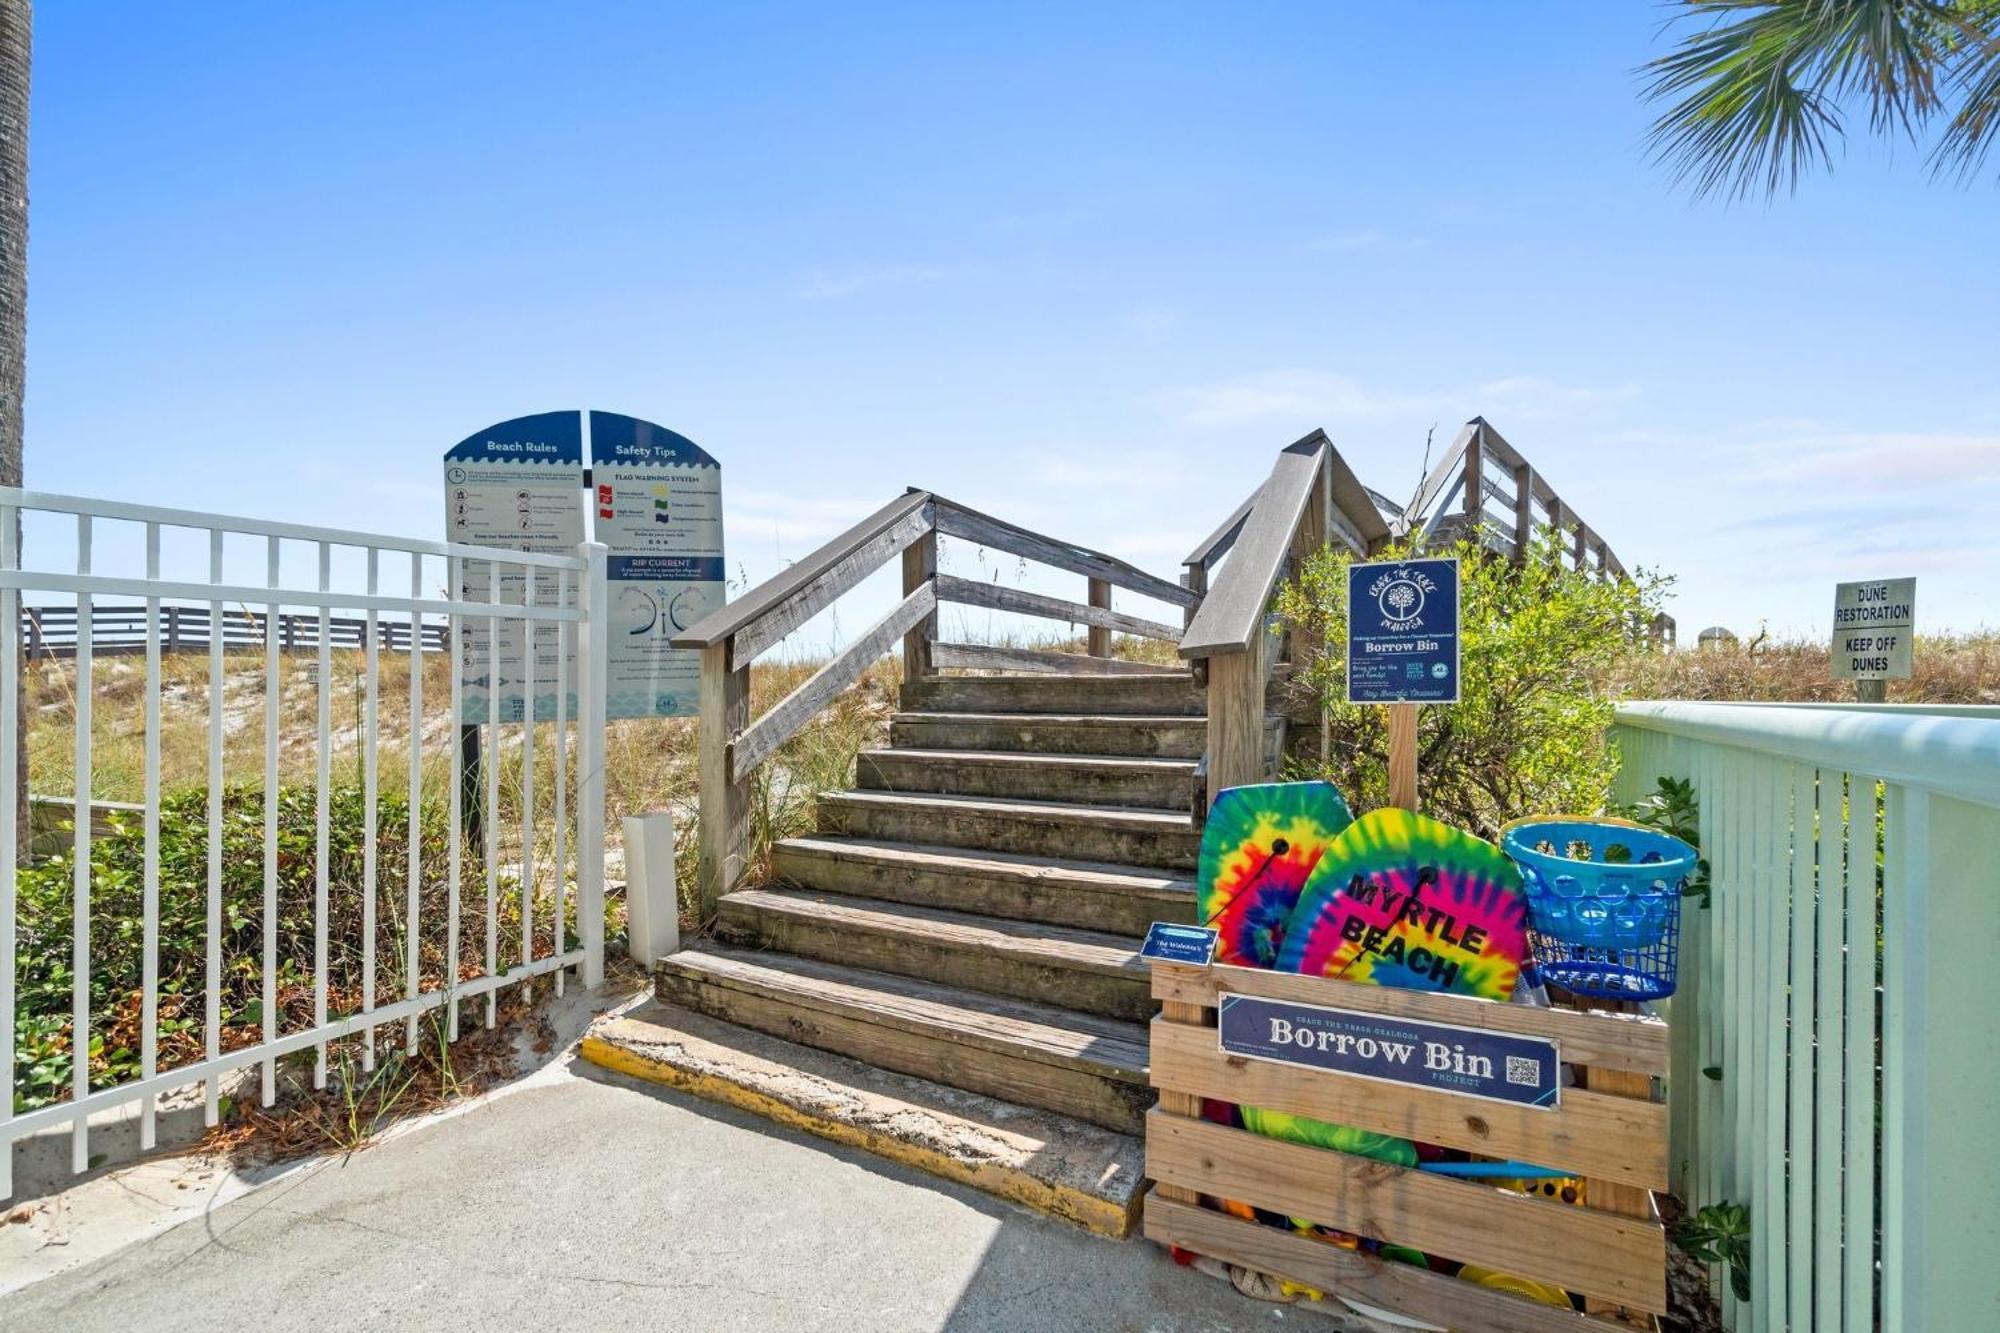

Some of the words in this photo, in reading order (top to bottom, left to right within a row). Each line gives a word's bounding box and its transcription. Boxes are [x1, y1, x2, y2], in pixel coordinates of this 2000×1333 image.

[487, 441, 523, 452] Beach
[526, 442, 558, 453] Rules
[615, 445, 652, 458] Safety
[654, 447, 677, 458] Tips
[615, 474, 633, 482] FLAG
[635, 474, 670, 482] WARNING
[672, 475, 700, 483] SYSTEM
[632, 559, 647, 567] RIP
[648, 559, 690, 567] CURRENT
[1858, 586, 1887, 602] DUNE
[1836, 604, 1910, 622] RESTORATION
[1365, 641, 1415, 653] Borrow
[1416, 639, 1439, 651] Bin
[1846, 637, 1873, 652] KEEP
[1876, 636, 1897, 651] OFF
[1852, 657, 1888, 671] DUNES
[1347, 873, 1488, 955] MYRTLE
[1340, 914, 1461, 988] BEACH
[1269, 1017, 1415, 1065] Borrow
[1423, 1042, 1494, 1079] Bin
[1432, 1072, 1481, 1087] PROJECT
